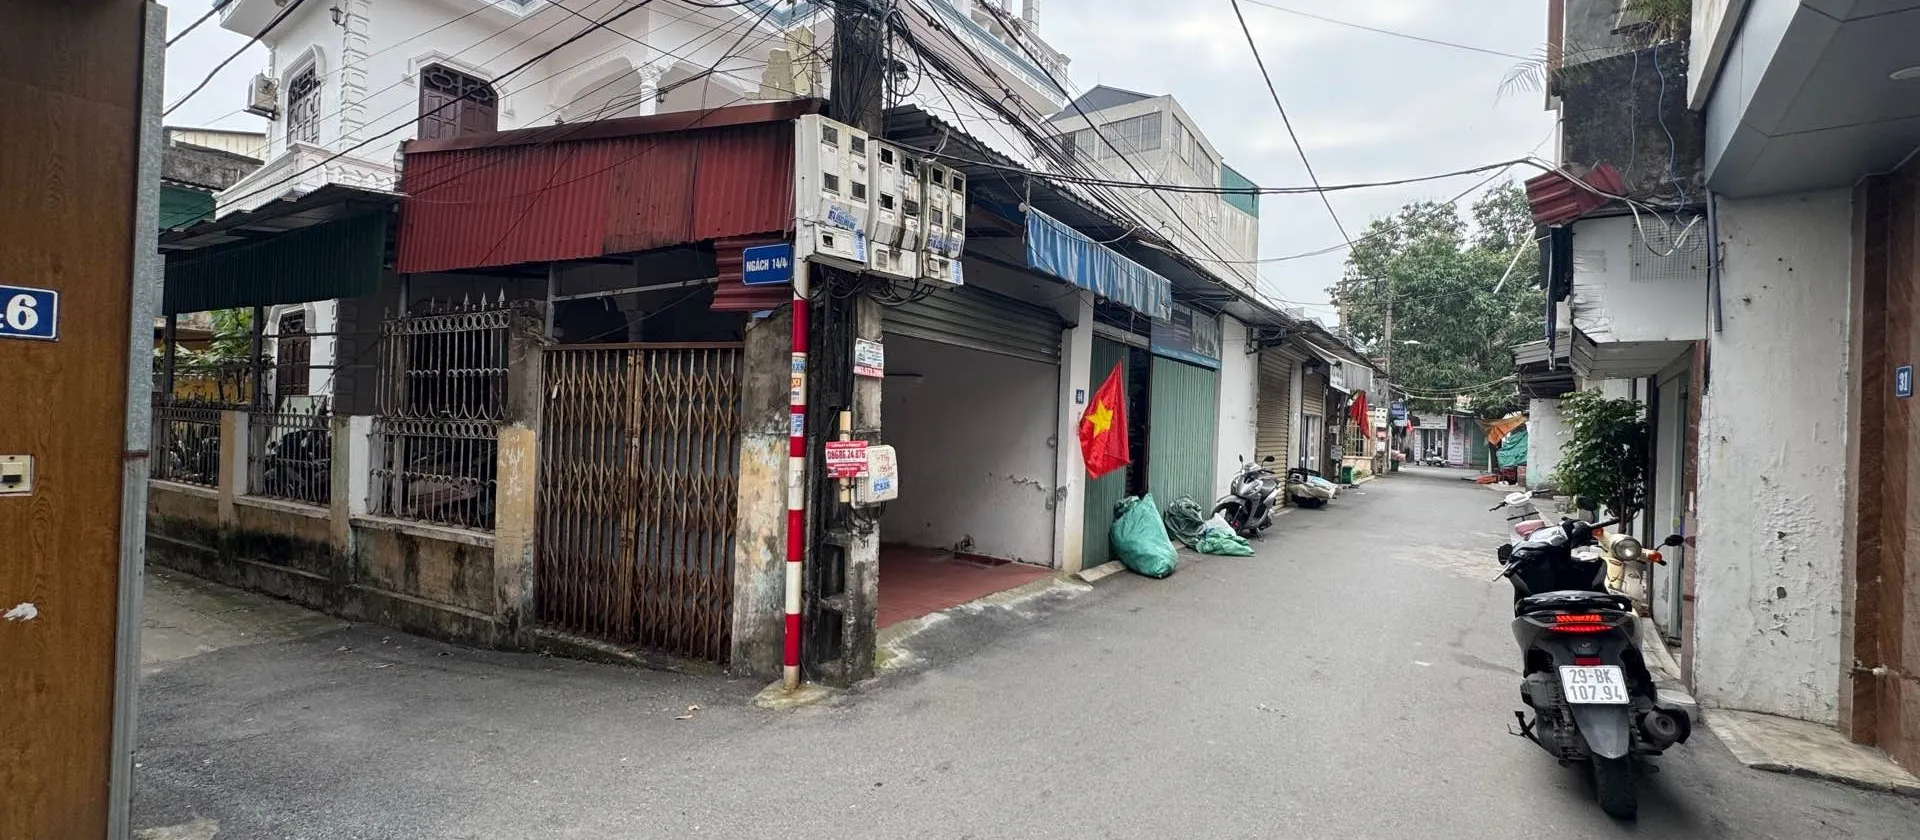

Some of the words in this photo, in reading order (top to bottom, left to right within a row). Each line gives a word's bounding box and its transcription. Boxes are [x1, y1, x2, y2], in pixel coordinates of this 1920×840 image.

[0, 294, 38, 330] 6
[1899, 371, 1908, 391] 31
[1569, 669, 1613, 683] 29-BK
[1570, 685, 1623, 700] 107.94
